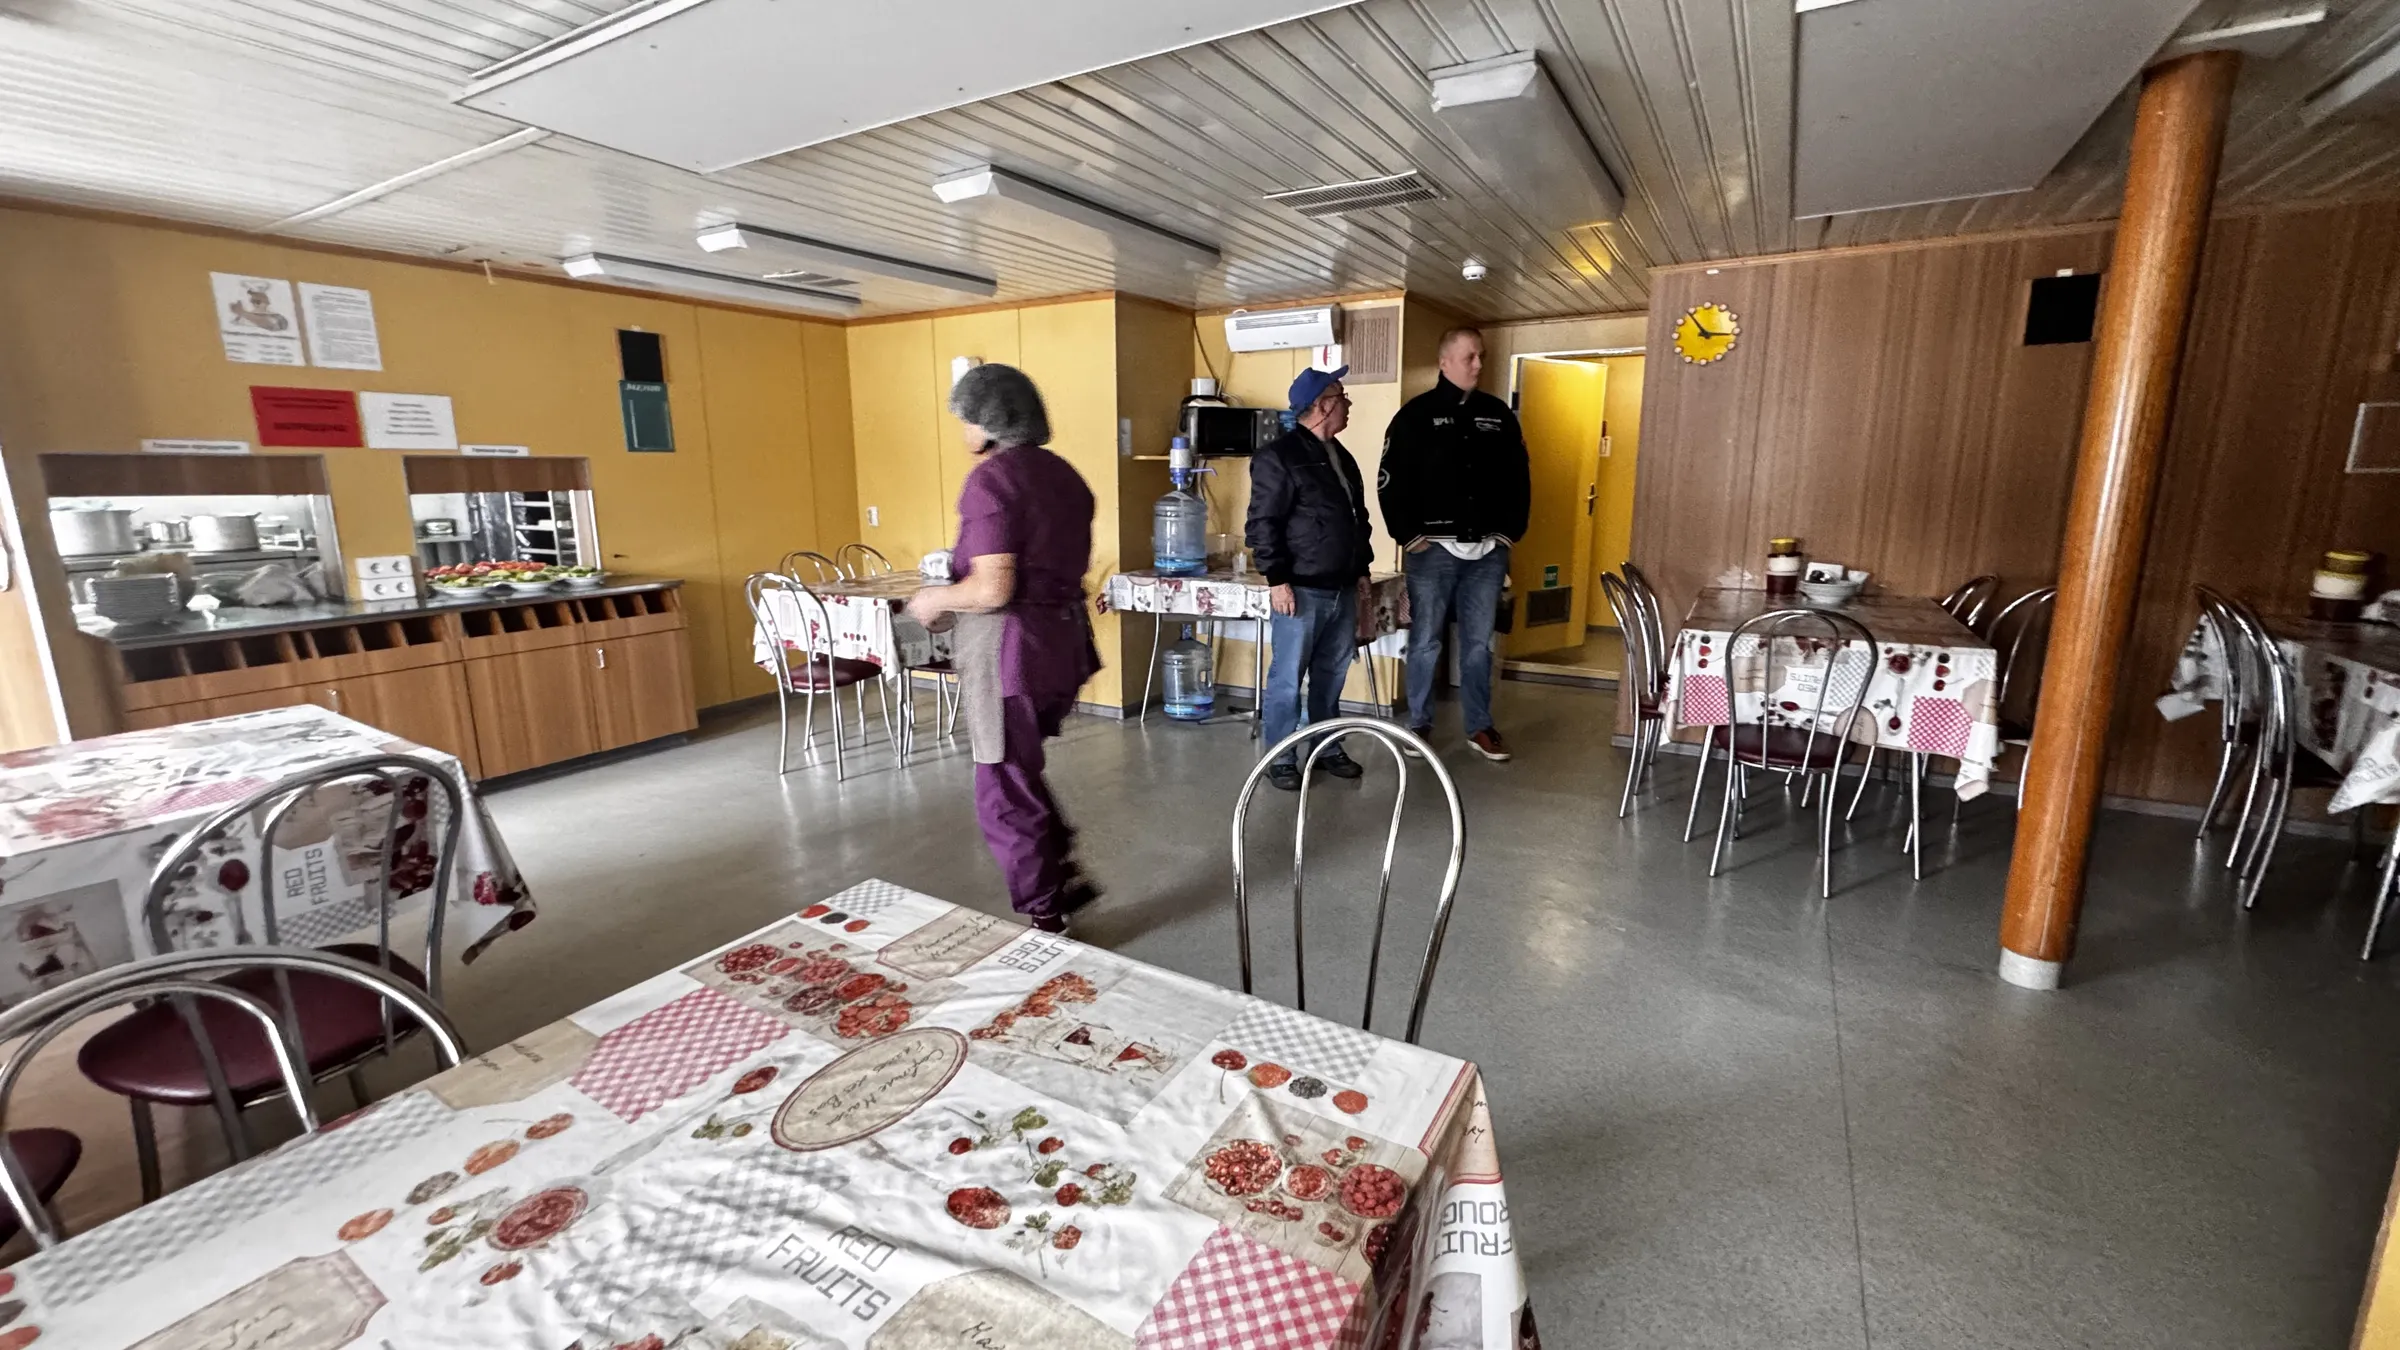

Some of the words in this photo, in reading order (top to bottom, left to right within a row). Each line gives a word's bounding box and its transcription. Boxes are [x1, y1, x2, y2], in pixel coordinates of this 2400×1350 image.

[285, 868, 305, 898] RED
[304, 848, 330, 906] FRUITS
[1442, 1200, 1510, 1228] ROUG
[827, 1224, 898, 1273] RED
[1430, 1230, 1514, 1264] FRUIT
[766, 1232, 892, 1322] FRUITS
